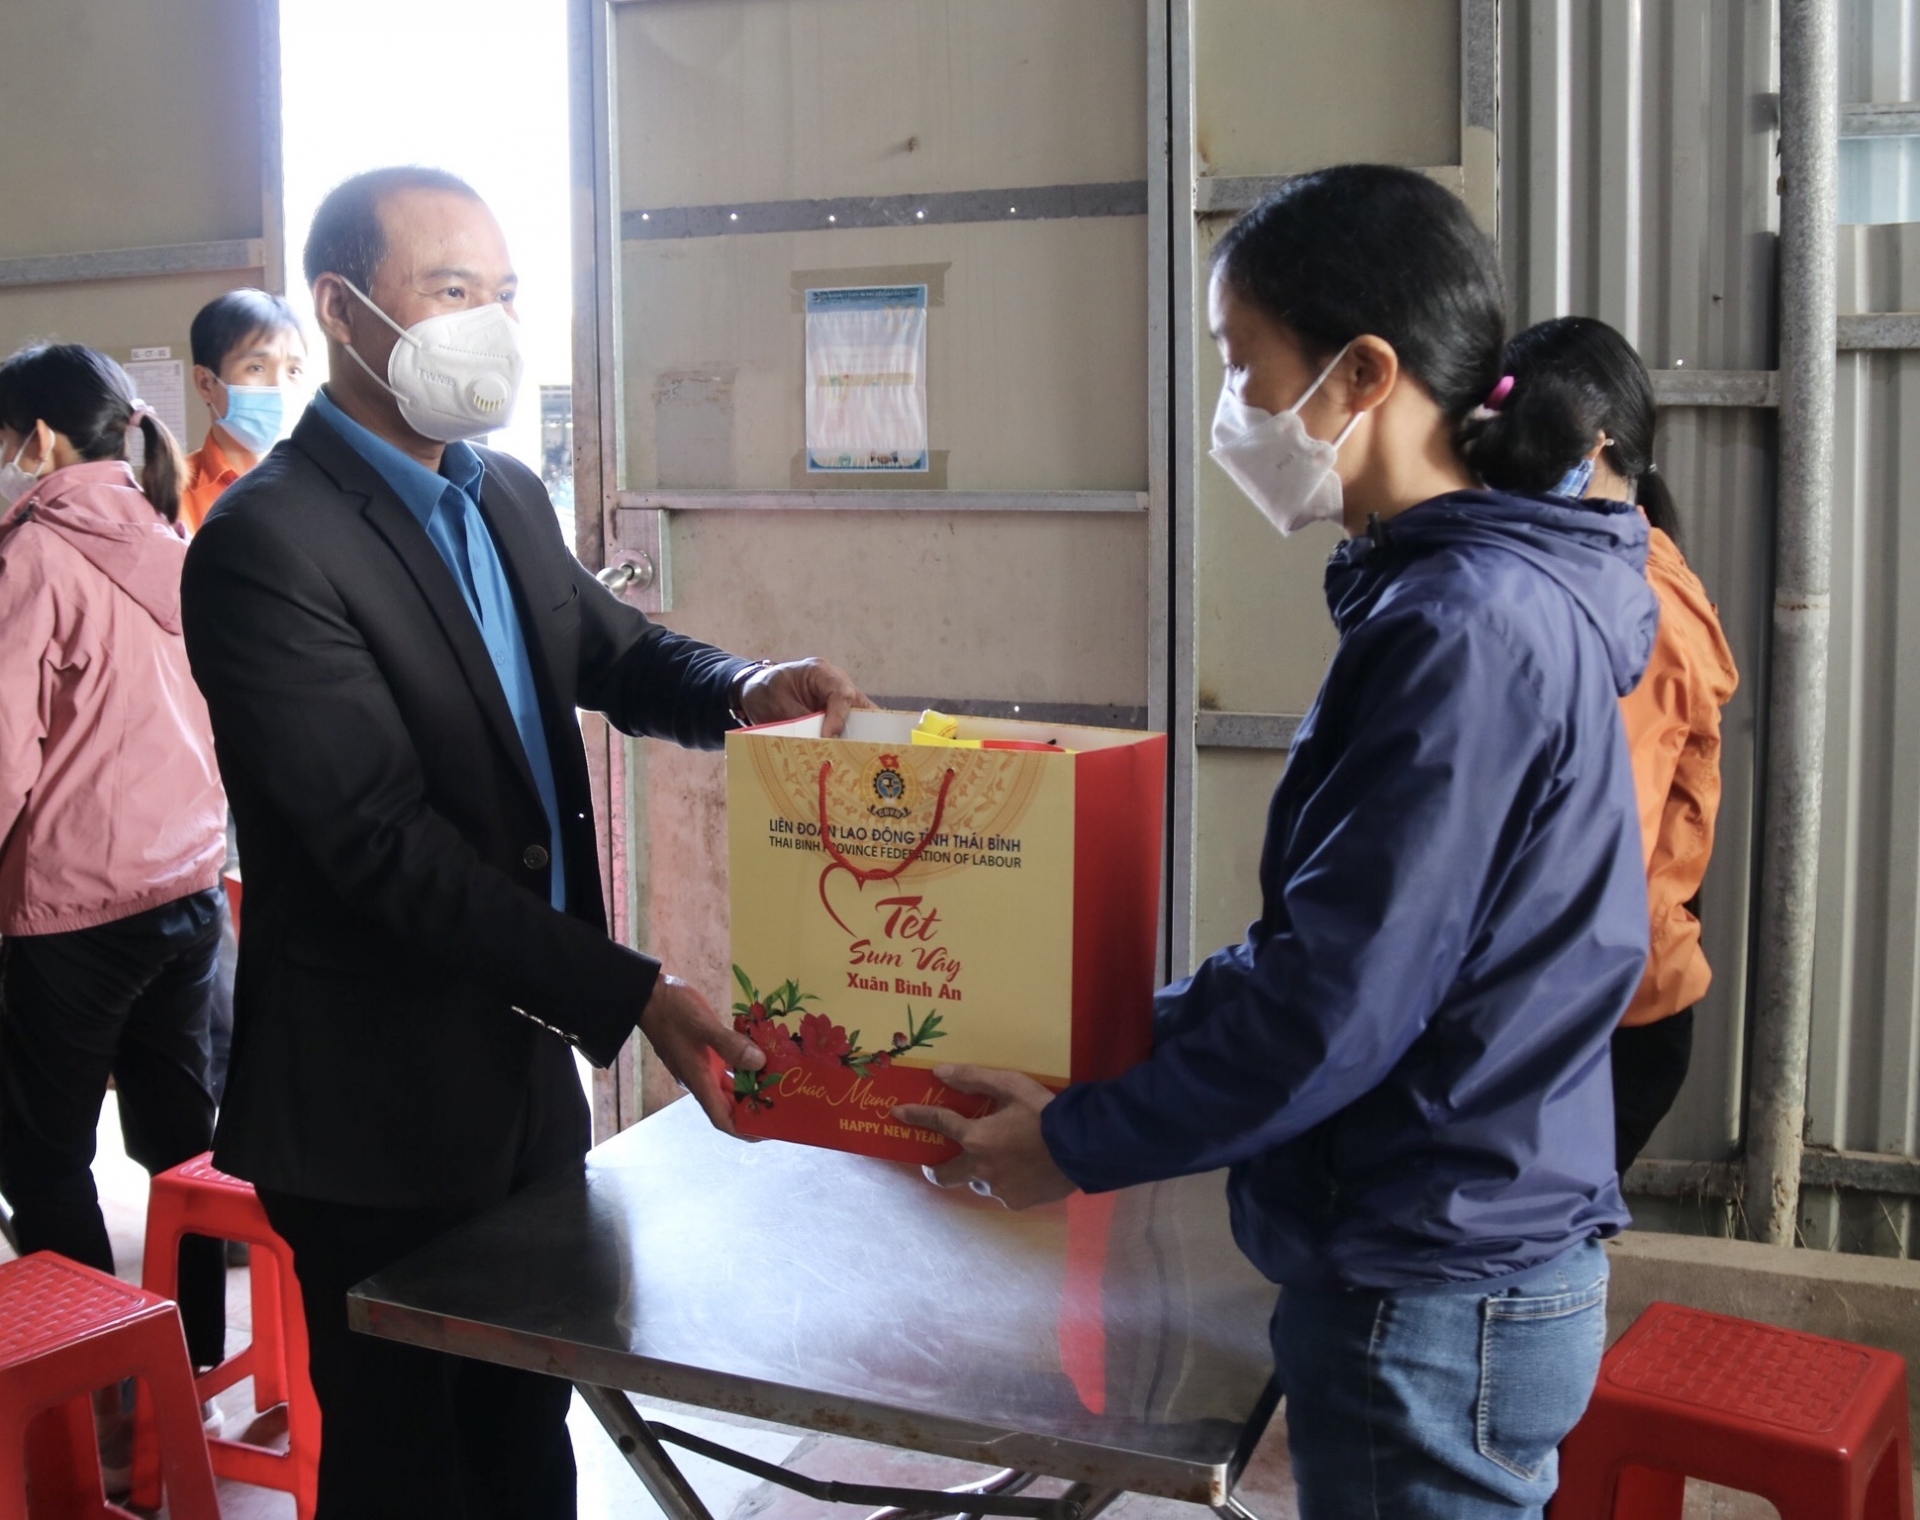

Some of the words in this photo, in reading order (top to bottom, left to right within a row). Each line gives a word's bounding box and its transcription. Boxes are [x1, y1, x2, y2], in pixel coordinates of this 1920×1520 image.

[769, 817, 793, 834] LIÊN
[840, 825, 867, 840] LAO
[872, 826, 915, 845] ĐỘNG
[953, 832, 983, 850] THÁI
[988, 833, 1021, 853] BÌNH
[769, 835, 792, 848] THAI
[795, 838, 820, 852] BINH
[822, 842, 878, 857] OVINCE
[953, 852, 969, 864] OF
[972, 854, 1021, 868] LABOUR
[846, 972, 889, 992] Xuân
[895, 978, 932, 997] Bình
[938, 983, 962, 1001] An
[840, 1119, 880, 1134] HAPPY
[884, 1125, 911, 1139] NEW
[914, 1129, 945, 1145] YEAR
